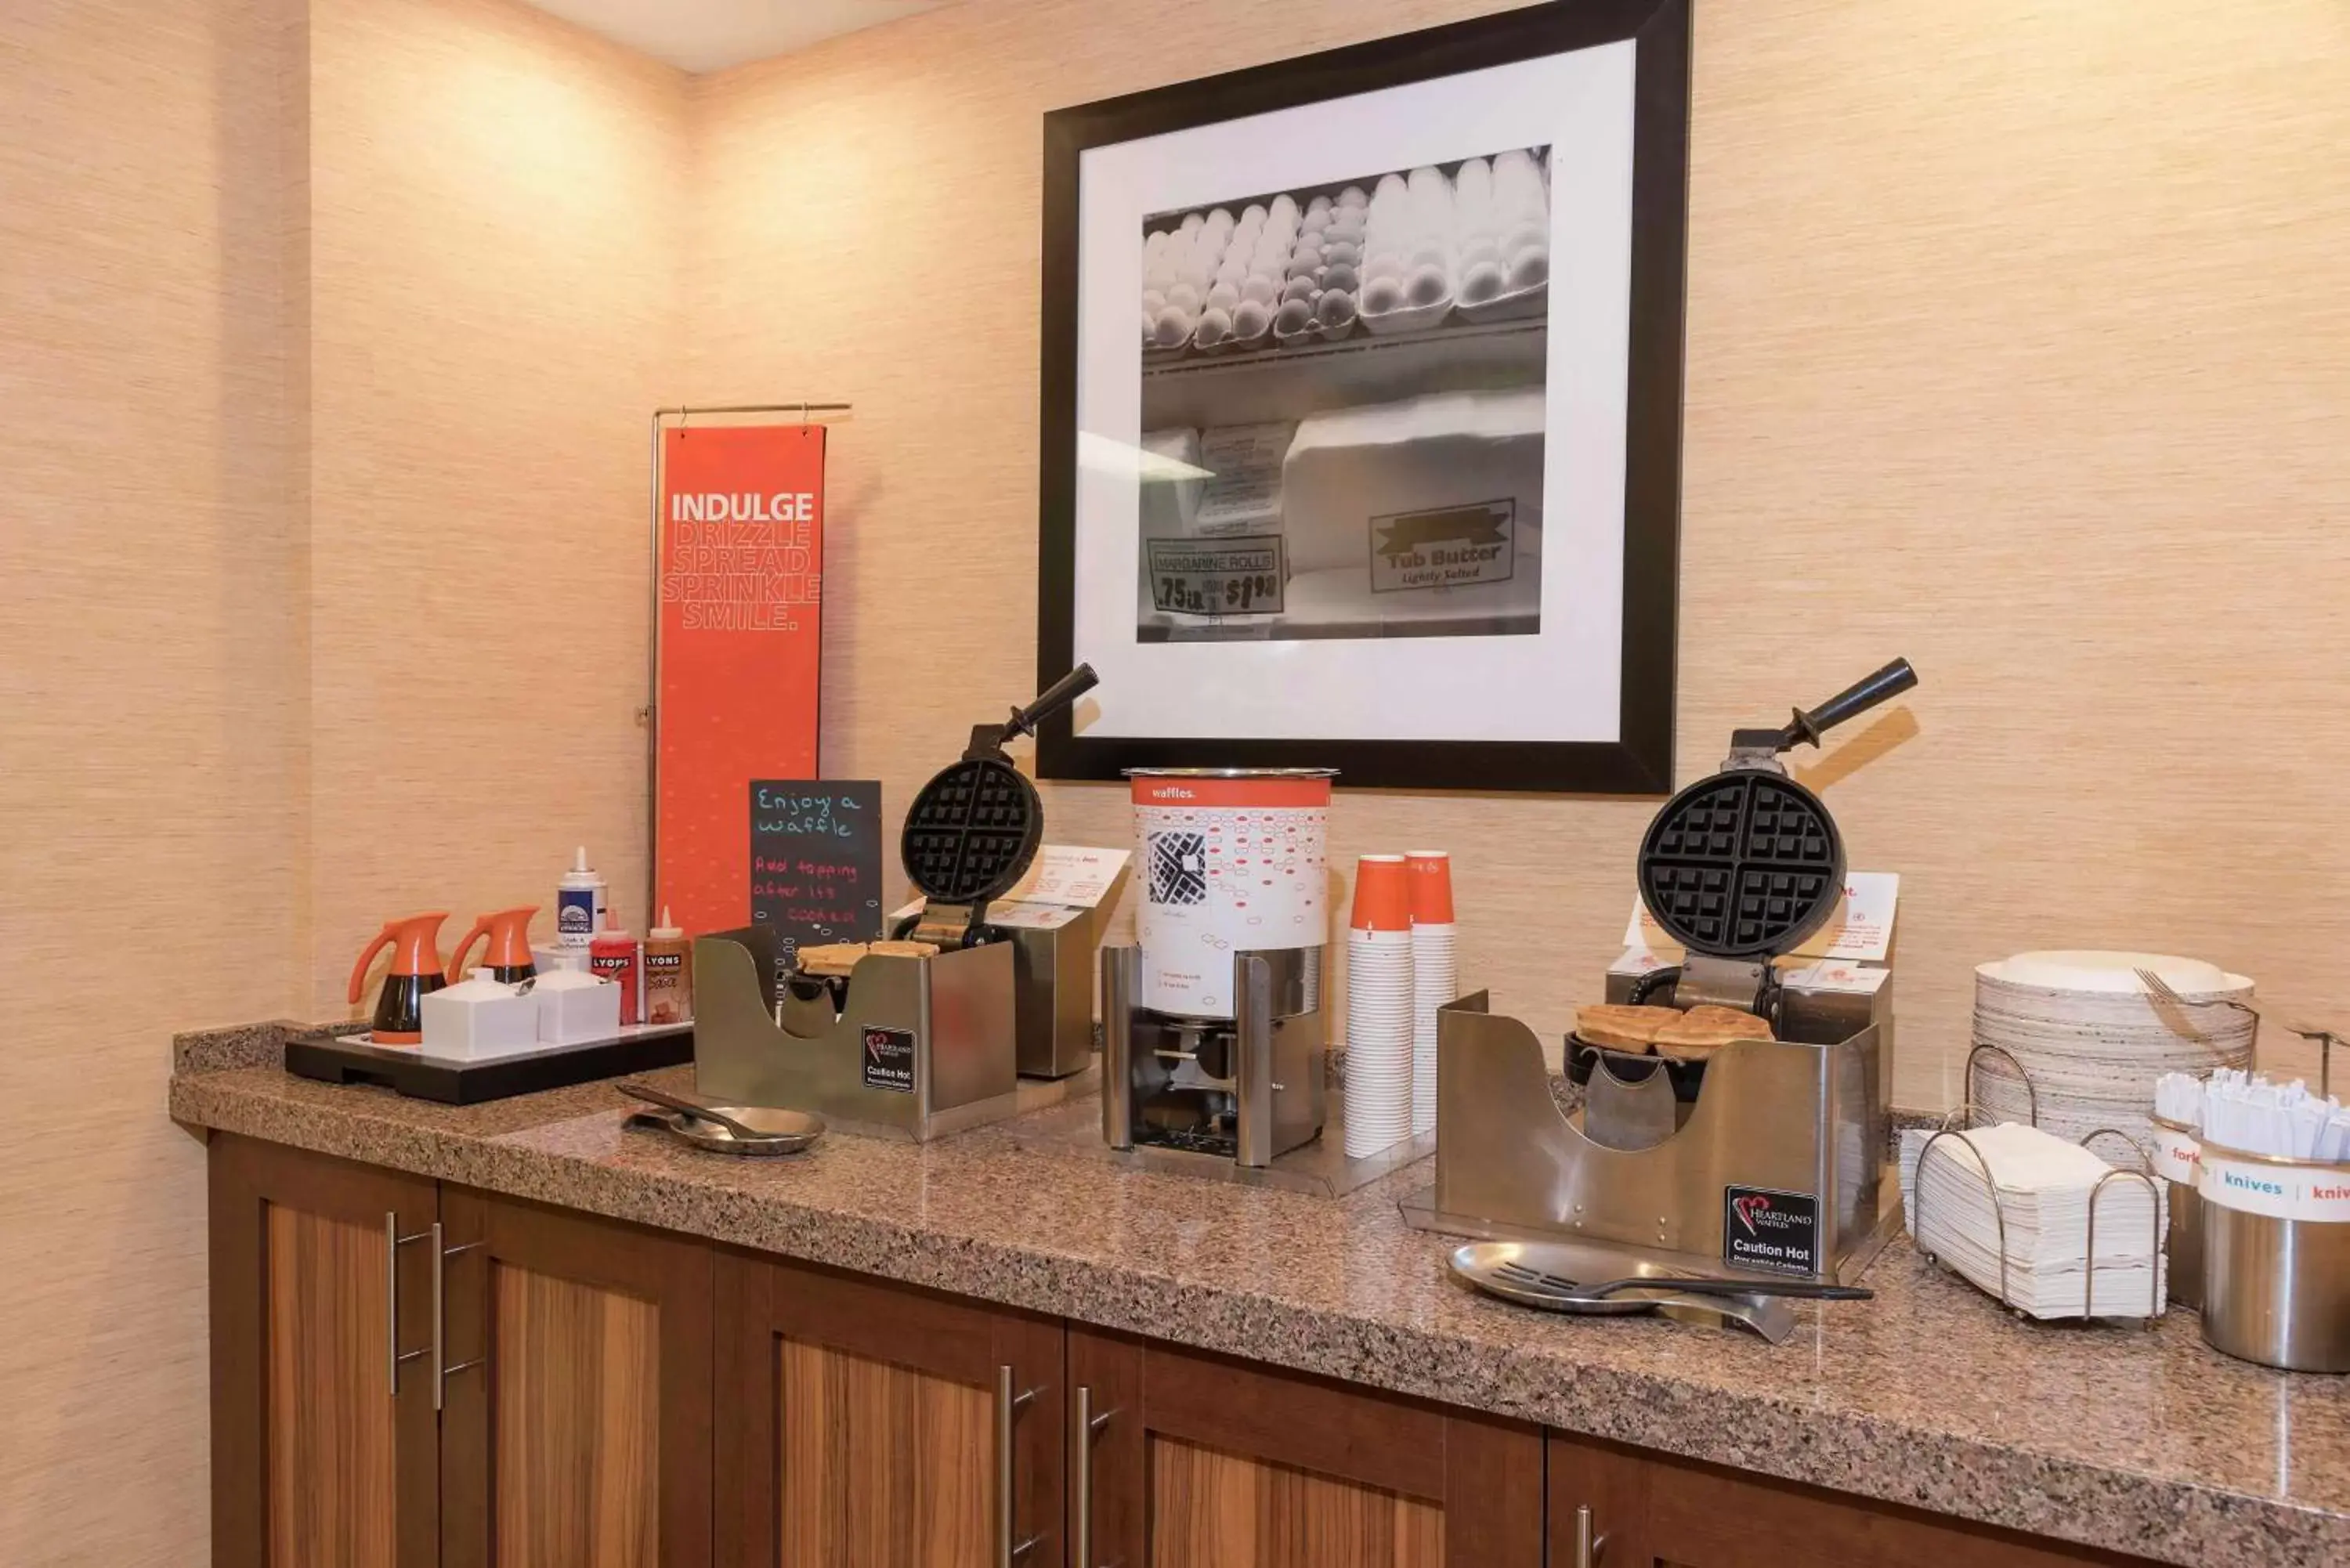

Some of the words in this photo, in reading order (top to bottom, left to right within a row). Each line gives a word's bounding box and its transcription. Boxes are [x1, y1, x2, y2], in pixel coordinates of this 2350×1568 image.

[672, 493, 814, 521] INDULGE
[674, 519, 811, 547] DRIZZLE
[672, 546, 812, 576] SPREAD
[1386, 551, 1426, 569] Tub
[1431, 545, 1502, 566] Butter
[663, 573, 822, 603] SPRINKLE
[683, 601, 798, 630] SMILE.
[757, 789, 831, 818] Enjoy
[841, 796, 861, 809] a
[1152, 786, 1196, 798] waffles.
[758, 817, 852, 837] waffle
[755, 856, 787, 873] Add
[797, 859, 857, 883] topping
[646, 956, 680, 965] LYONS
[2225, 1172, 2283, 1195] knives
[1750, 1208, 1812, 1226] HEARTLAND
[1734, 1238, 1782, 1257] Caution
[1786, 1246, 1810, 1260] Hot
